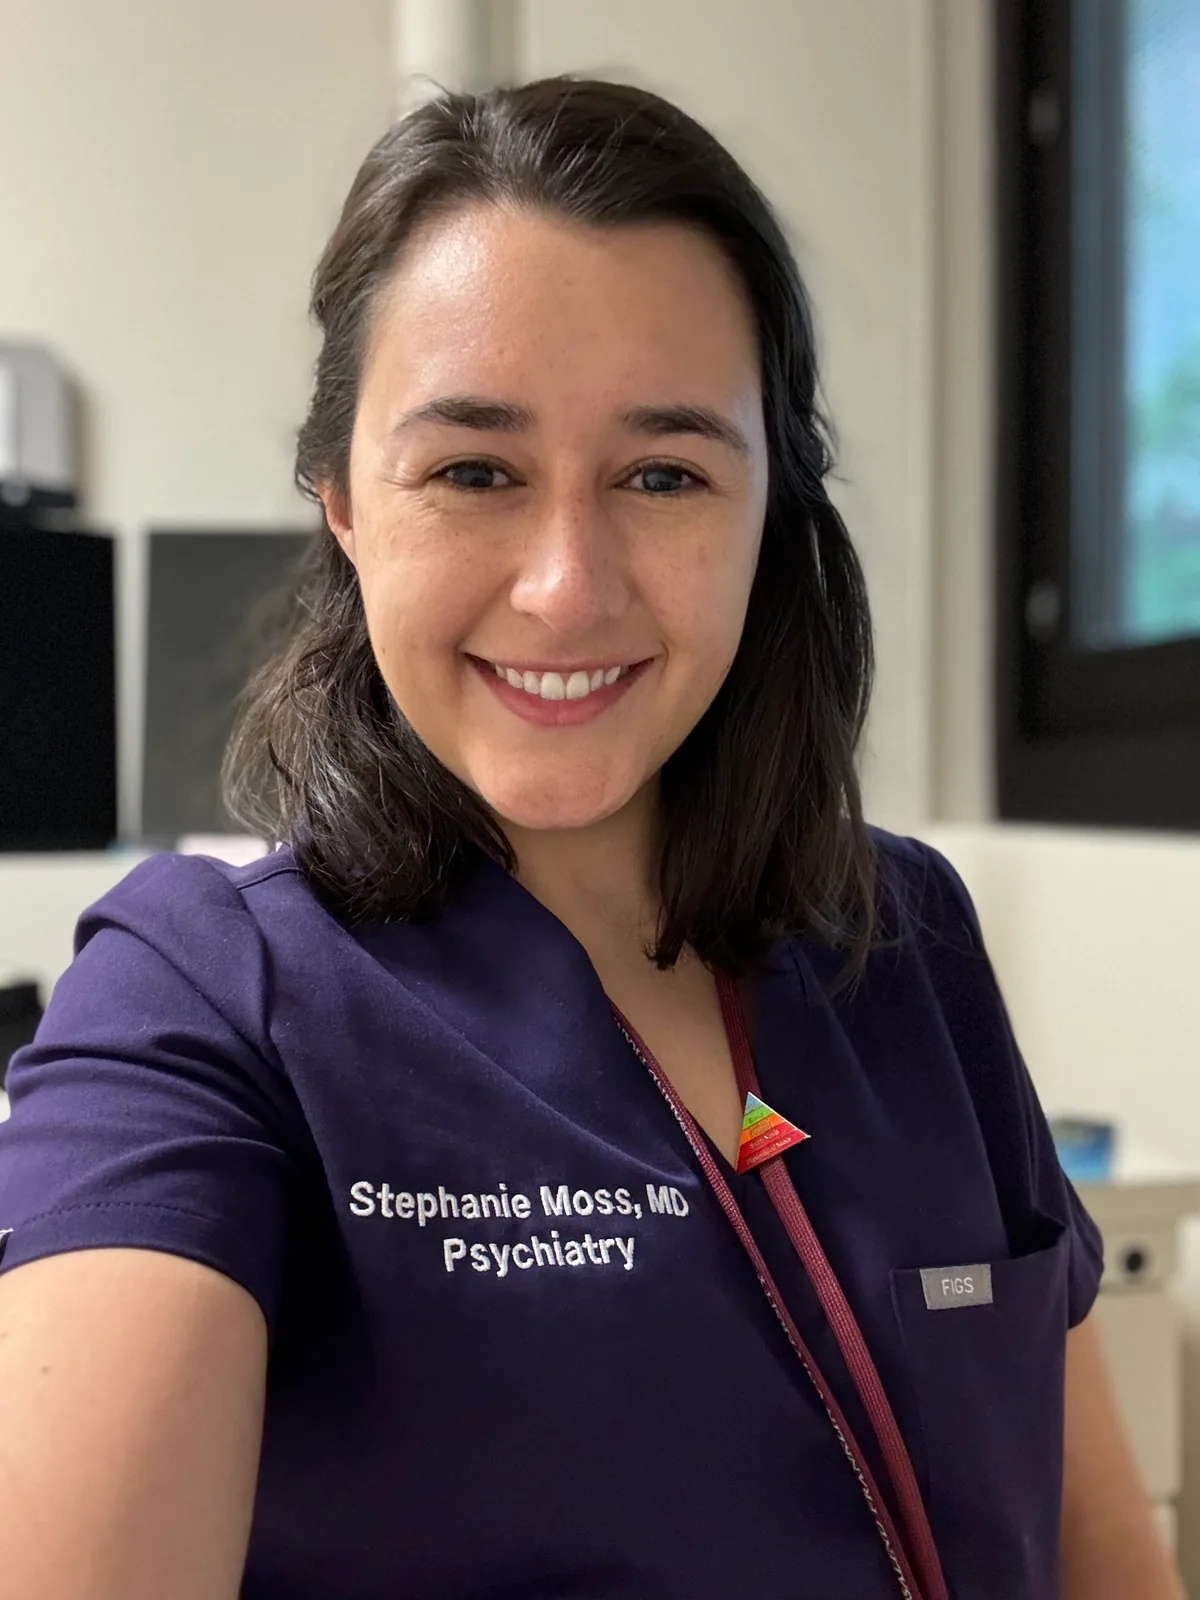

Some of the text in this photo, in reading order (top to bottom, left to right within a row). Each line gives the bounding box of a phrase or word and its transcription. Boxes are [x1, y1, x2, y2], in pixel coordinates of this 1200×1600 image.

[349, 1180, 690, 1227] Stephanie Moss, MD
[443, 1231, 636, 1278] Psychiatry
[941, 1277, 974, 1296] FIGS
